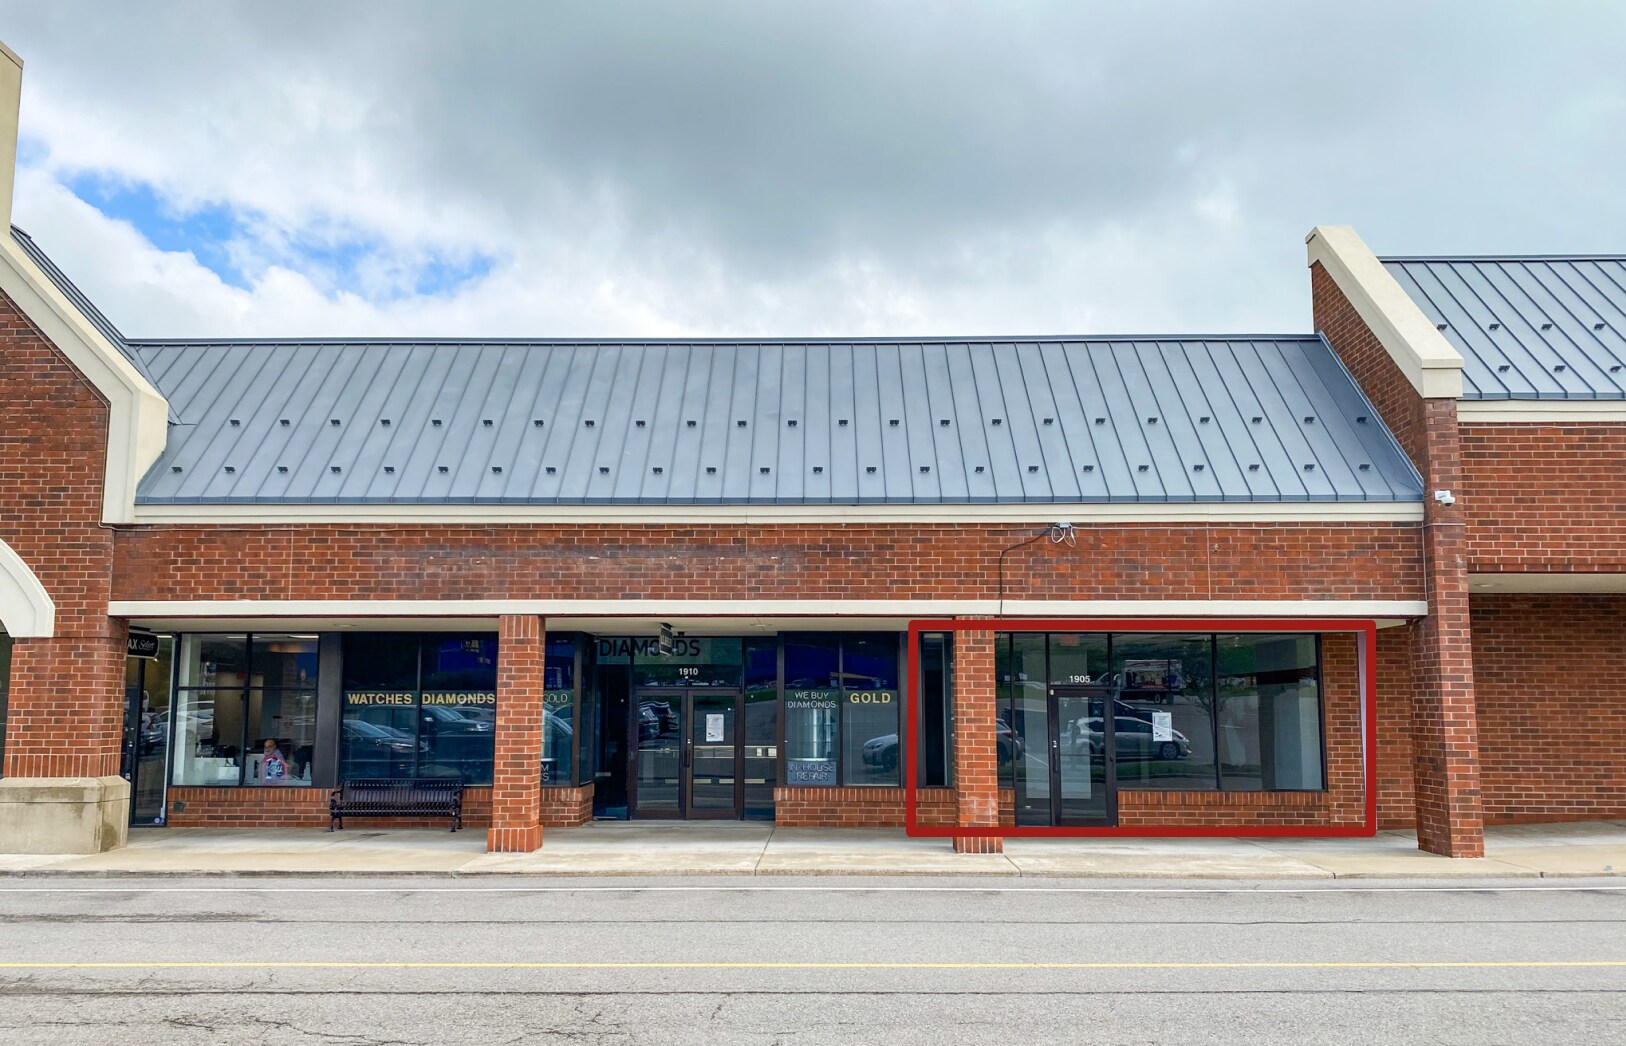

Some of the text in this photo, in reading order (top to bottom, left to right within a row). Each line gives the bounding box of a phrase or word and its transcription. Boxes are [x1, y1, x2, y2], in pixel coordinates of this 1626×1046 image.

[600, 639, 700, 657] DIAMODS
[679, 668, 699, 676] 1910
[1069, 675, 1091, 683] 1905
[347, 692, 496, 705] WATCHES DIAMONDS
[795, 692, 829, 700] WE BUY
[850, 692, 891, 704] GOLD
[787, 700, 837, 709] DIAMONDS
[796, 771, 828, 781] REPAIR
